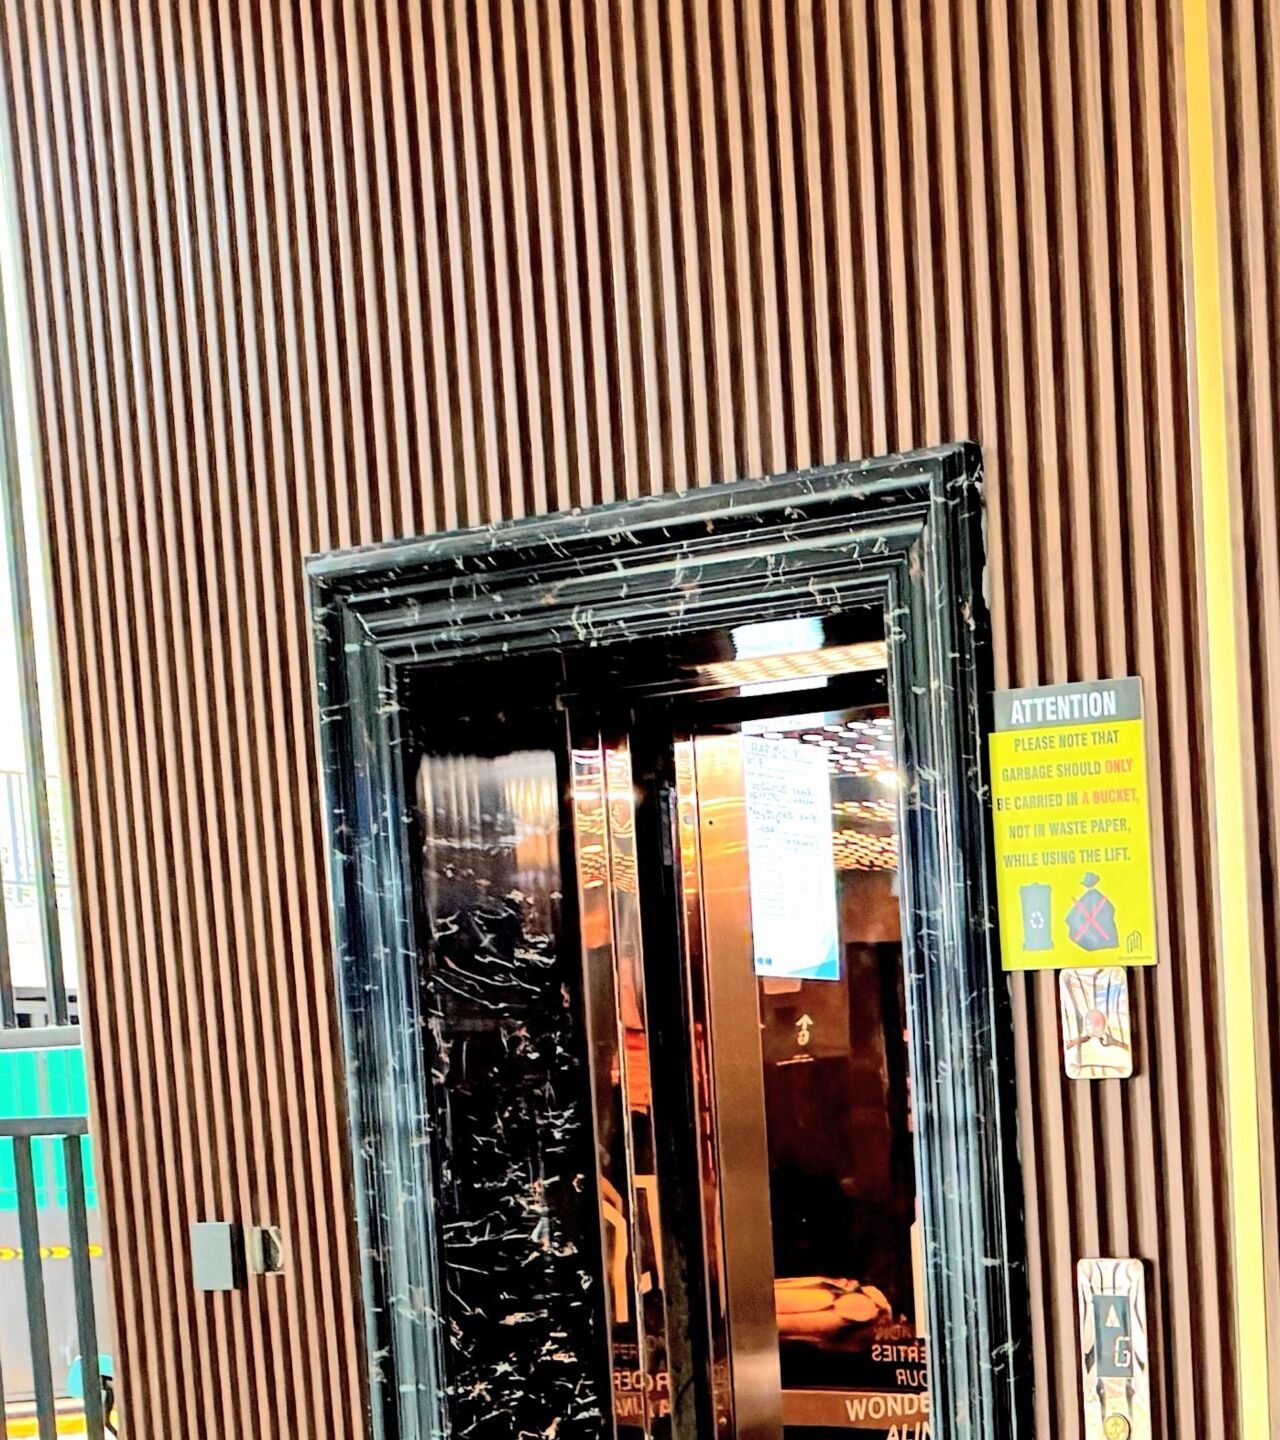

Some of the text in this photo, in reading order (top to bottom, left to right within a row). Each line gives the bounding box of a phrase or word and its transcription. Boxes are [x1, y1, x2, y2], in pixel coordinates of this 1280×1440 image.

[1011, 690, 1116, 725] ATTENTION
[1014, 729, 1119, 752] PLEASE NOTE THAT
[1001, 758, 1133, 782] GARBAGE SHOULD ONLY
[997, 787, 1140, 811] BE CARRIED IN A BUCKET,
[1008, 818, 1131, 840] NOT IN WASTE PAPER,
[1003, 847, 1131, 868] WHILE USING THE LIFT.
[1114, 1336, 1131, 1368] G
